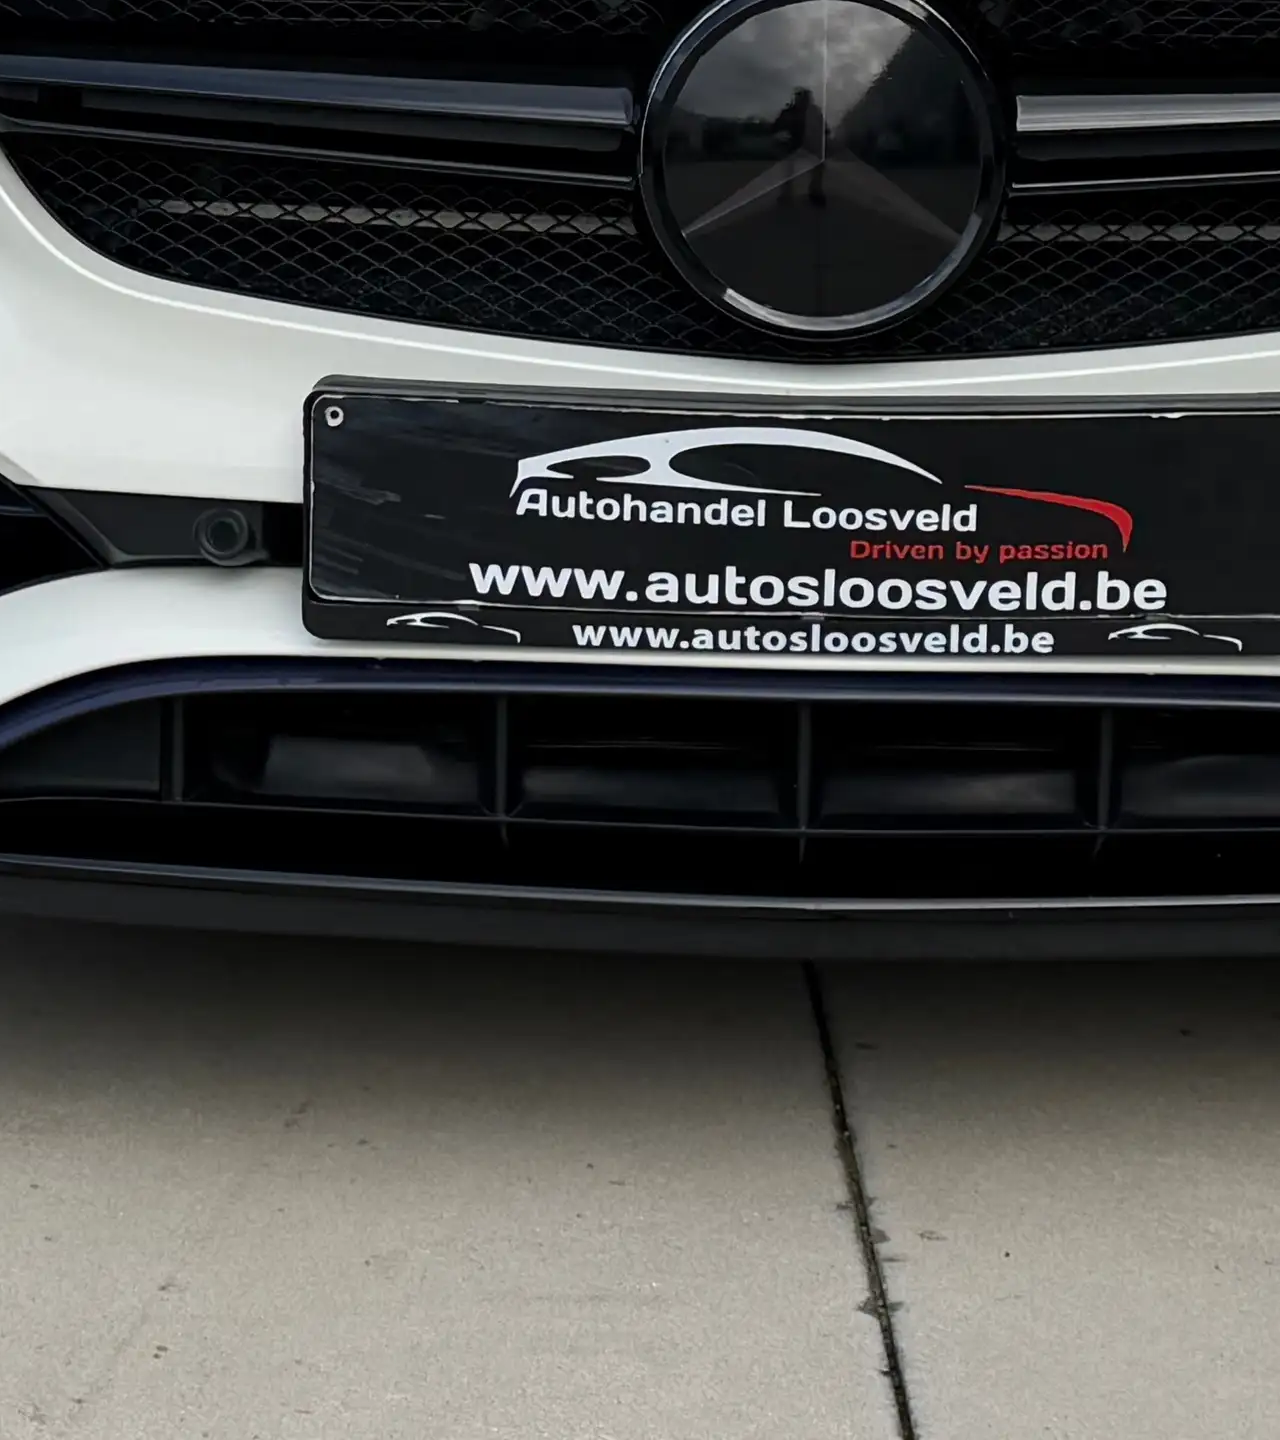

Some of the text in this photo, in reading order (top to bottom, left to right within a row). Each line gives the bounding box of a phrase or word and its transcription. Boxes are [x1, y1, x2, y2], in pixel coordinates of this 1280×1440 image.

[515, 488, 978, 532] Autohandel Loosveld
[850, 539, 1109, 566] Driven by passion
[468, 562, 1167, 611] www.autosloosveld.be
[572, 623, 1055, 654] www.autosloosveld.be
